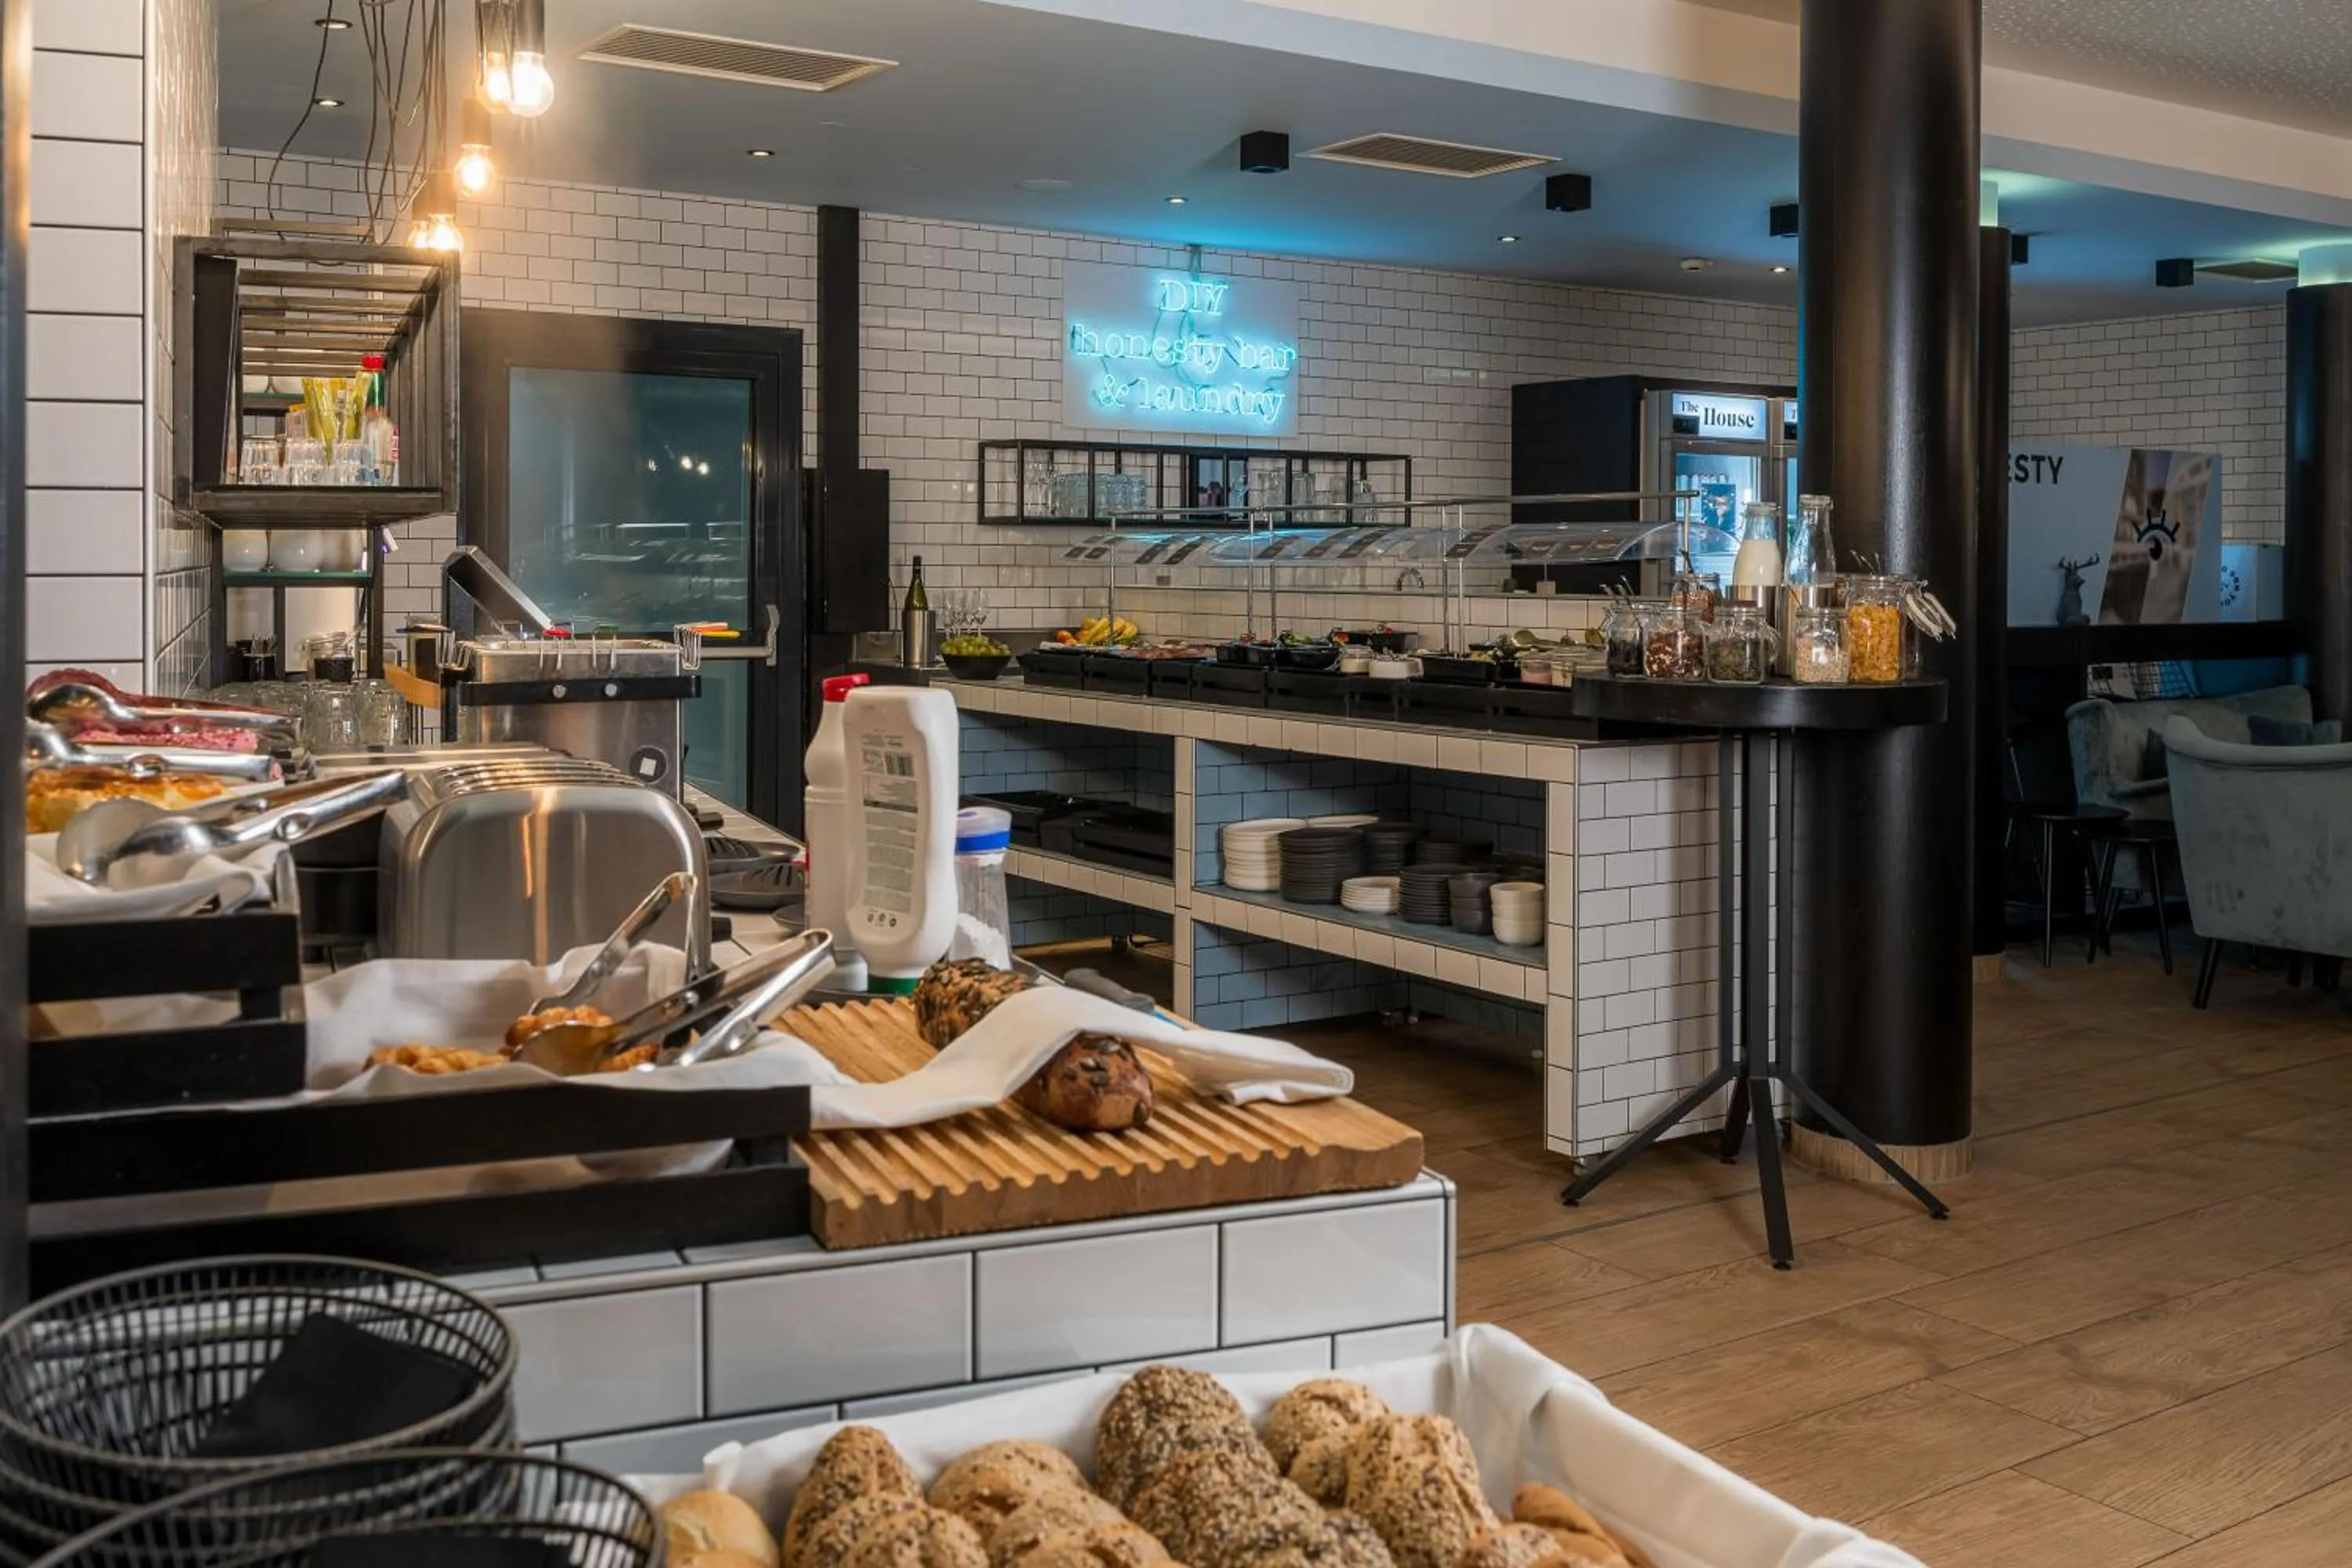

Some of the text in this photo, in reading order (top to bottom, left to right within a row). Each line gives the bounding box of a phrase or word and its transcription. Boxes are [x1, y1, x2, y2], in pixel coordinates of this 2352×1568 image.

[1160, 280, 1229, 315] DIY
[1075, 324, 1296, 374] honesty bar
[1098, 374, 1286, 423] & laundry
[1680, 401, 1755, 428] The House
